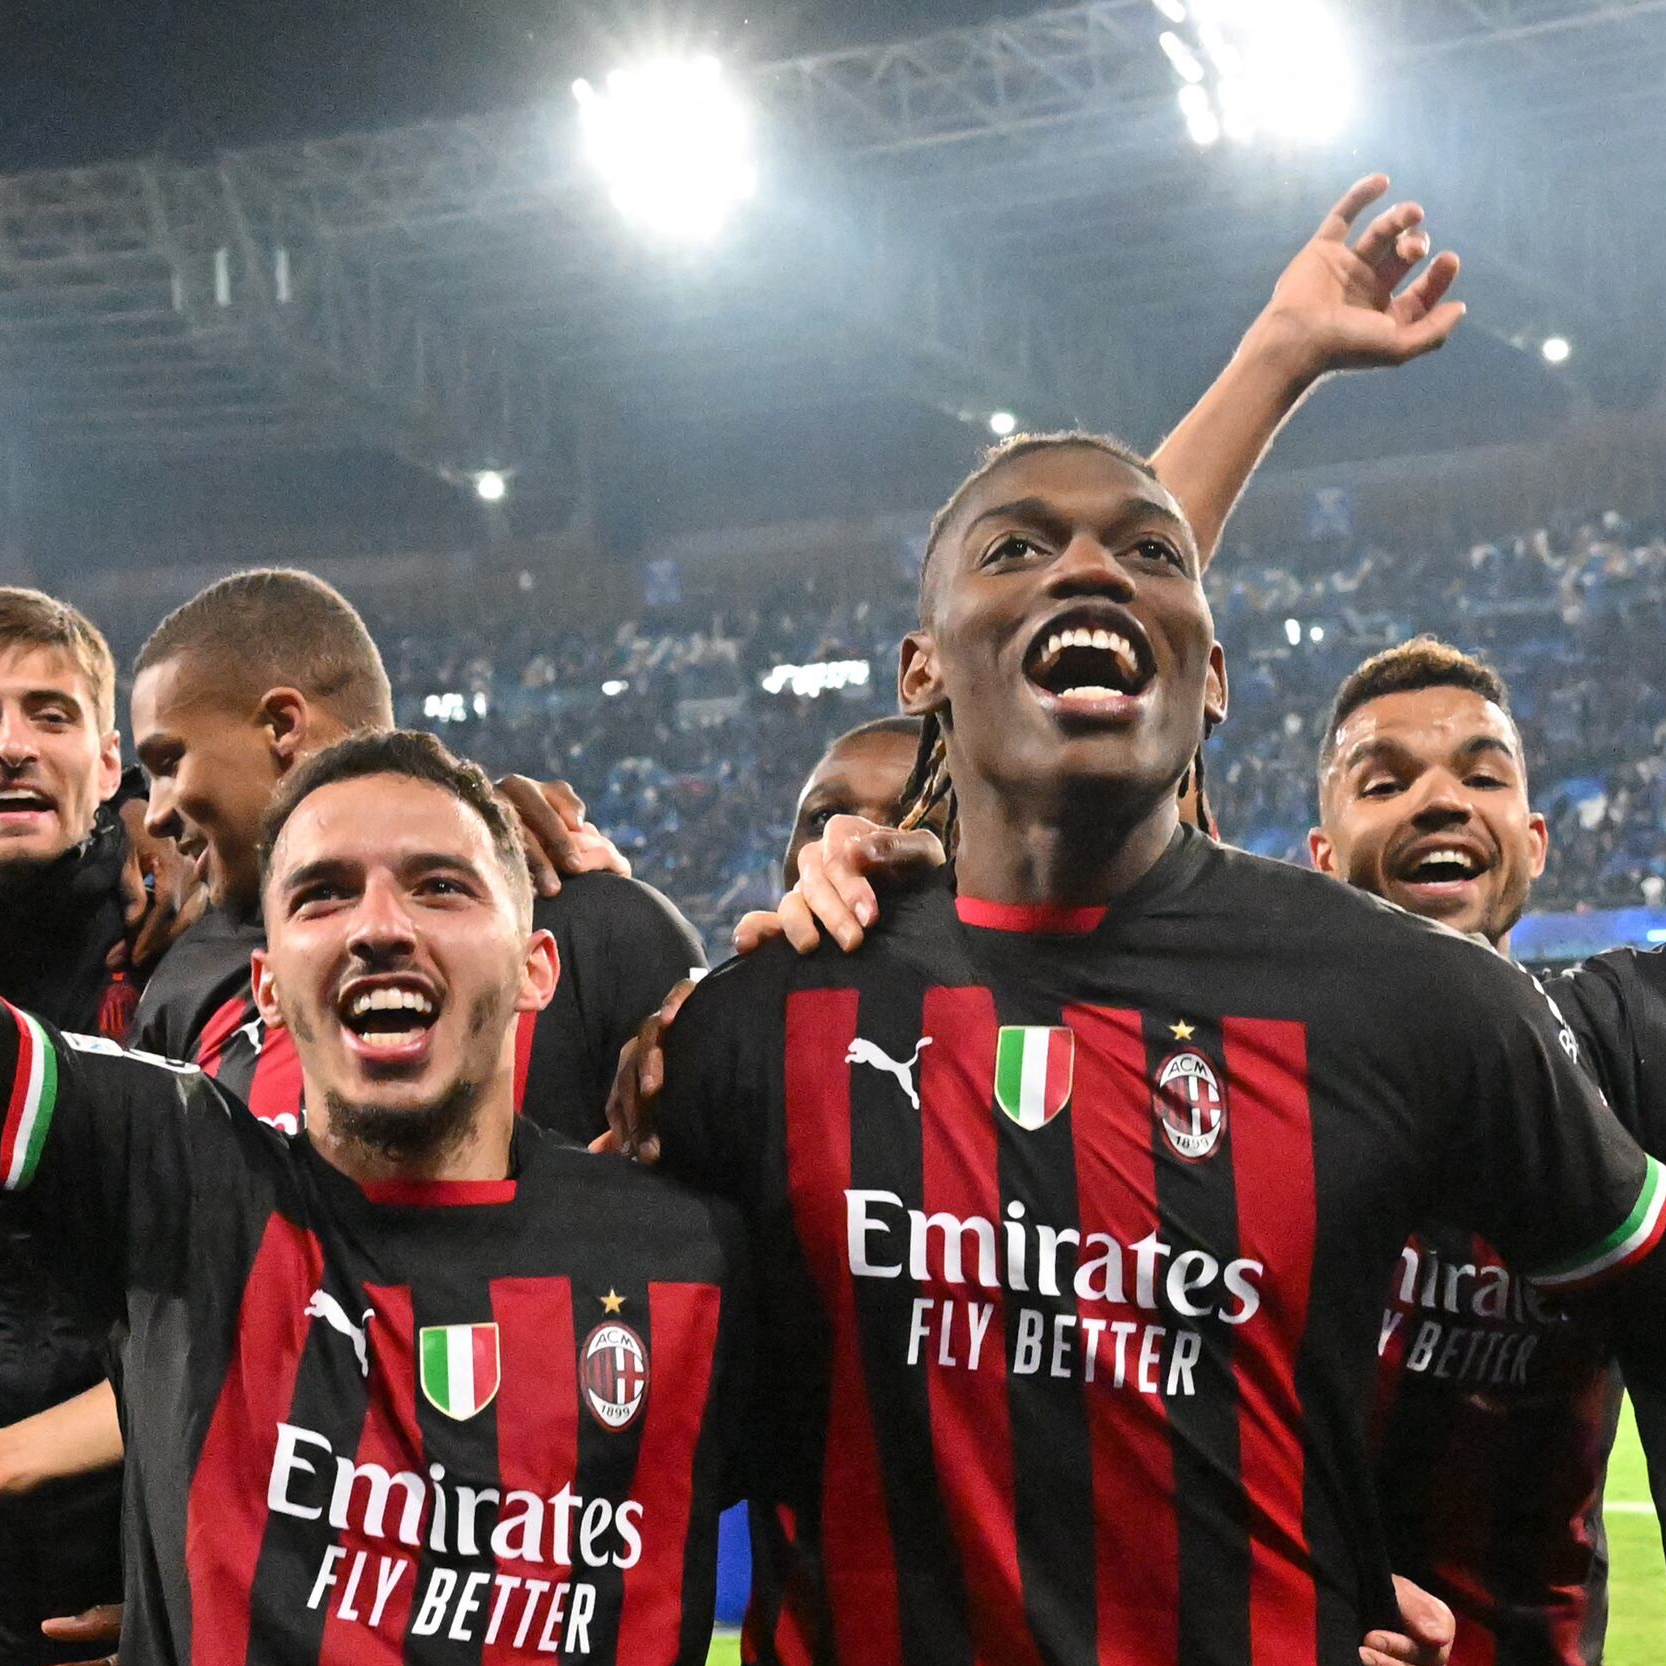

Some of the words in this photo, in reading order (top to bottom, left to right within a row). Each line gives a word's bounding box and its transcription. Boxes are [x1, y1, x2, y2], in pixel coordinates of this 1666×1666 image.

[1168, 1057, 1208, 1076] ACM
[844, 1189, 1264, 1325] Emirates
[596, 1330, 634, 1348] ACM
[907, 1298, 993, 1371] FLY
[1013, 1309, 1202, 1396] BETTER
[601, 1405, 631, 1418] 1899
[267, 1423, 644, 1570] Emirates
[307, 1545, 408, 1627] FLY
[412, 1567, 596, 1655] BETTER
